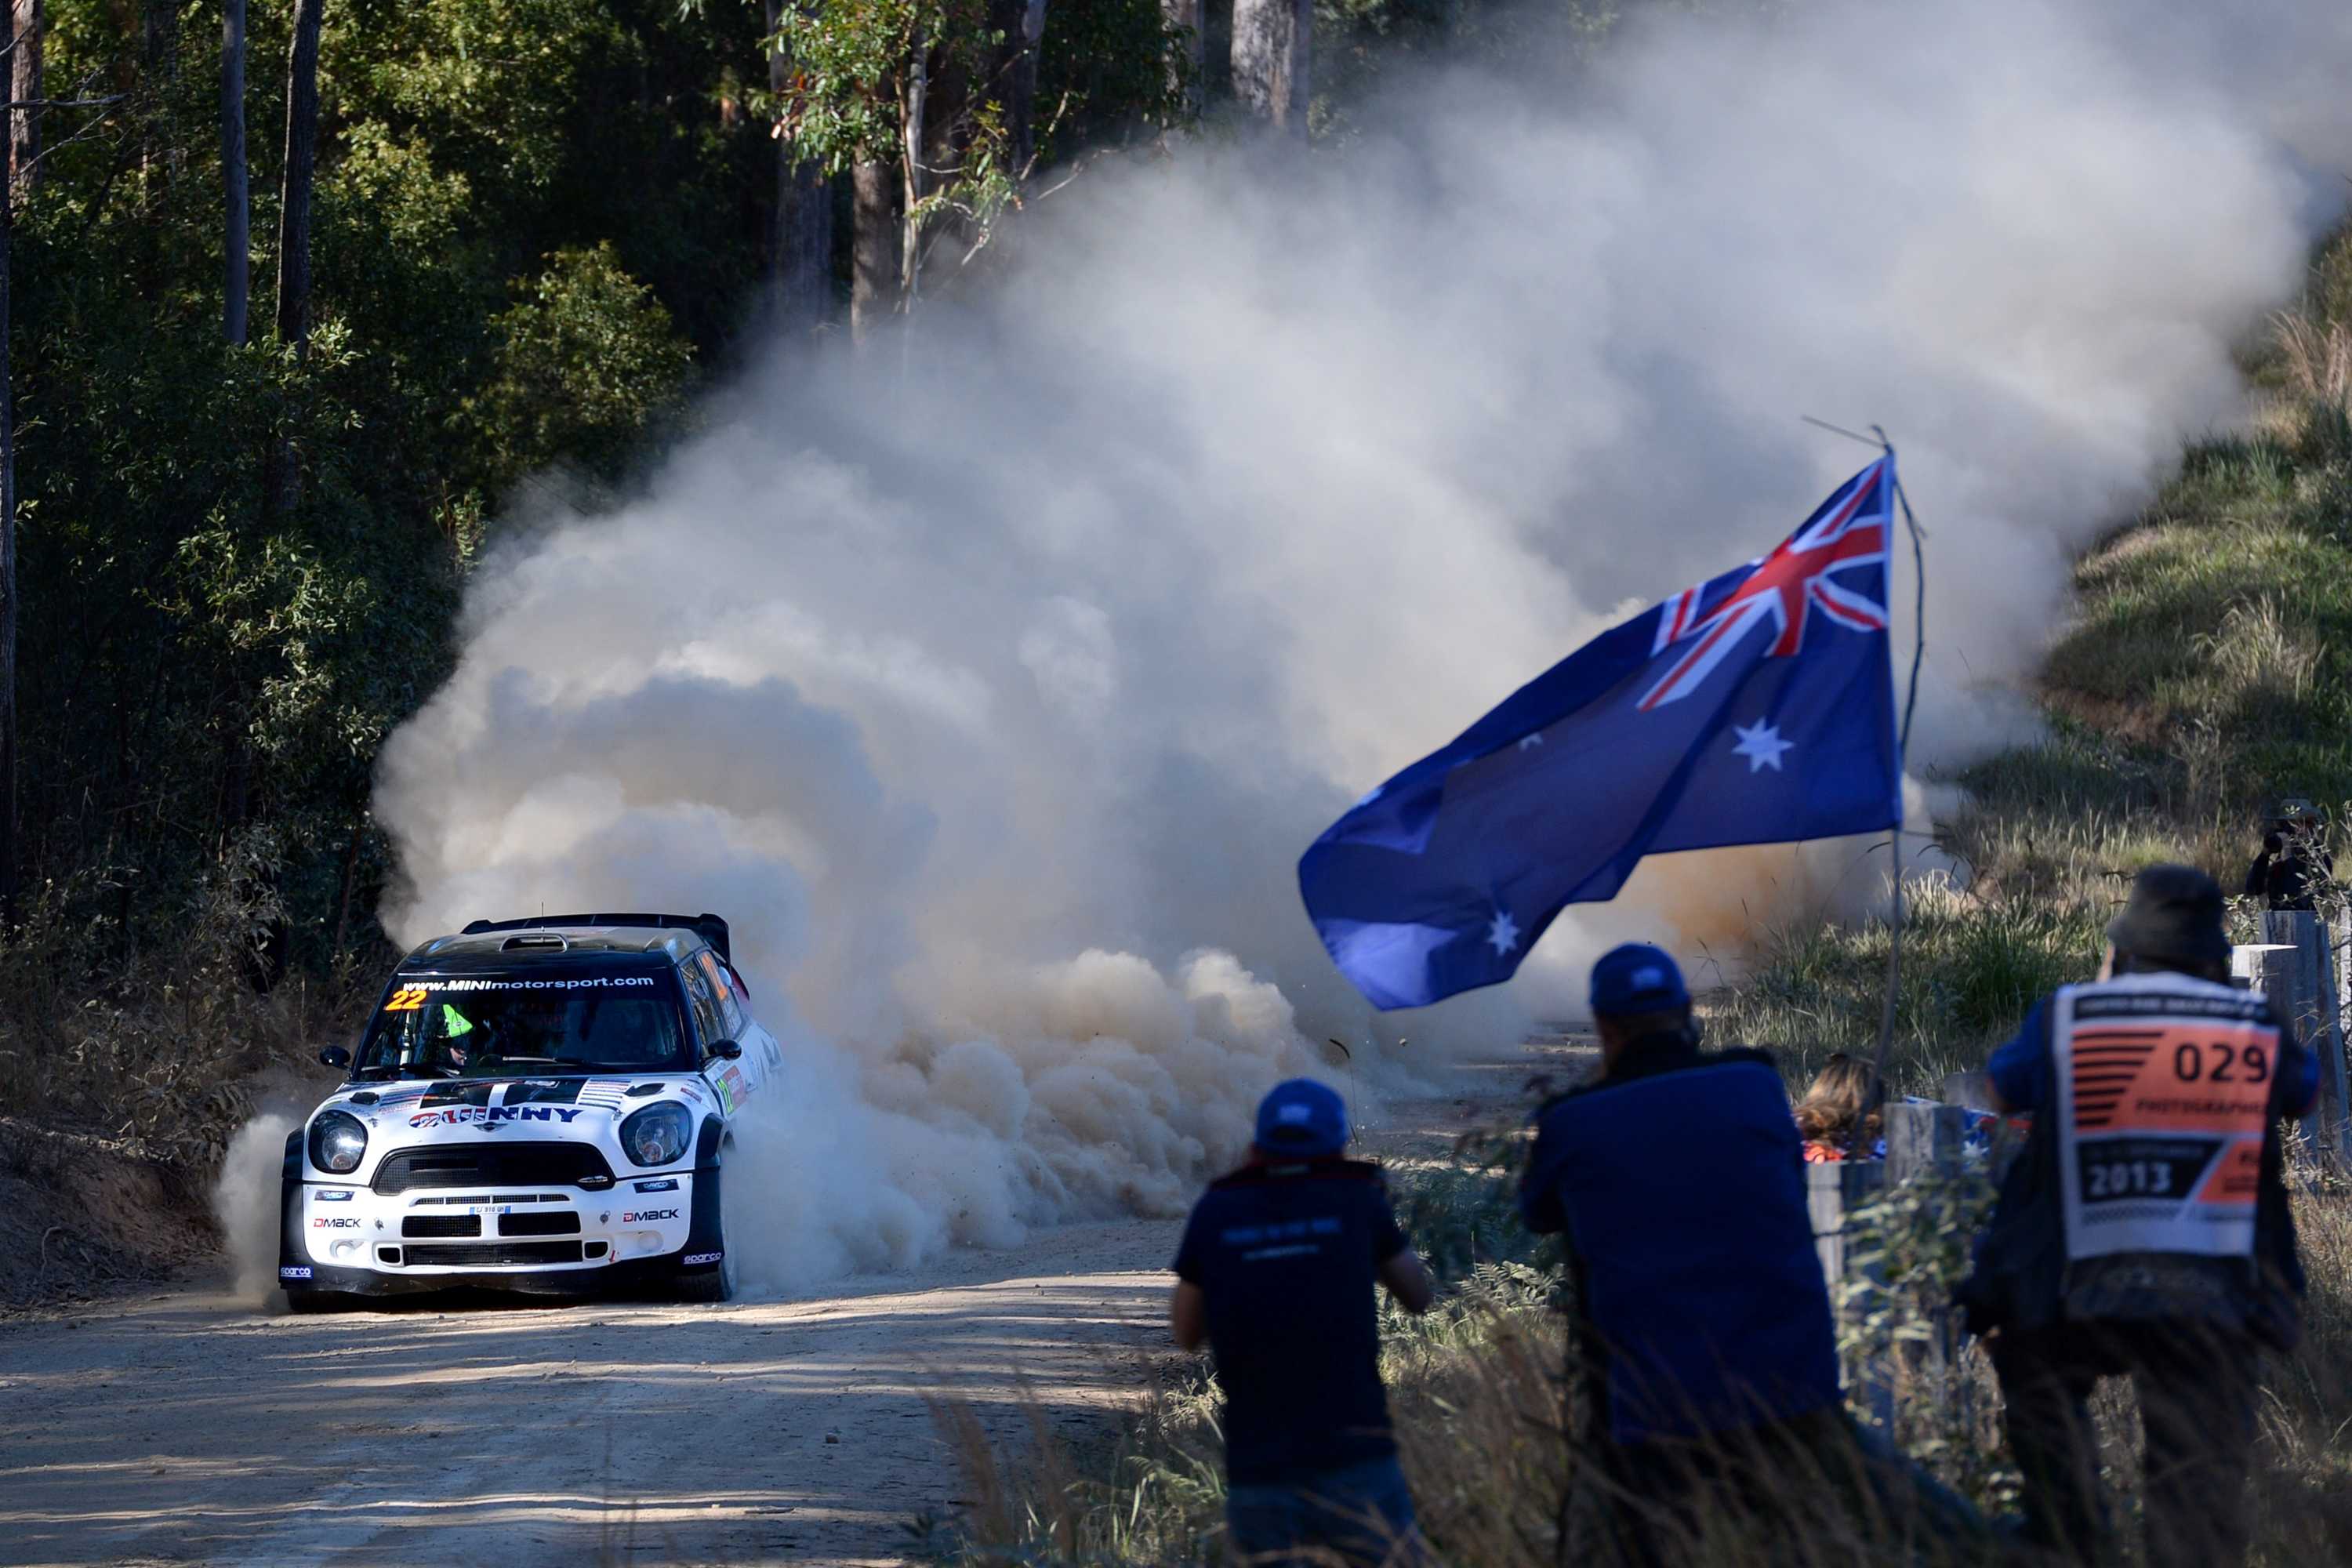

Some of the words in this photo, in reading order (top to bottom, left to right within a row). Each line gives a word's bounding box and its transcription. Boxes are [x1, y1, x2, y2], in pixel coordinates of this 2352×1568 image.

[402, 977, 654, 992] www.MINImotorsport.com
[385, 990, 427, 1011] 22
[2174, 1043, 2268, 1083] 029
[2087, 1160, 2172, 1196] 2013
[683, 1252, 722, 1265] sparco
[280, 1266, 311, 1277] sparco
